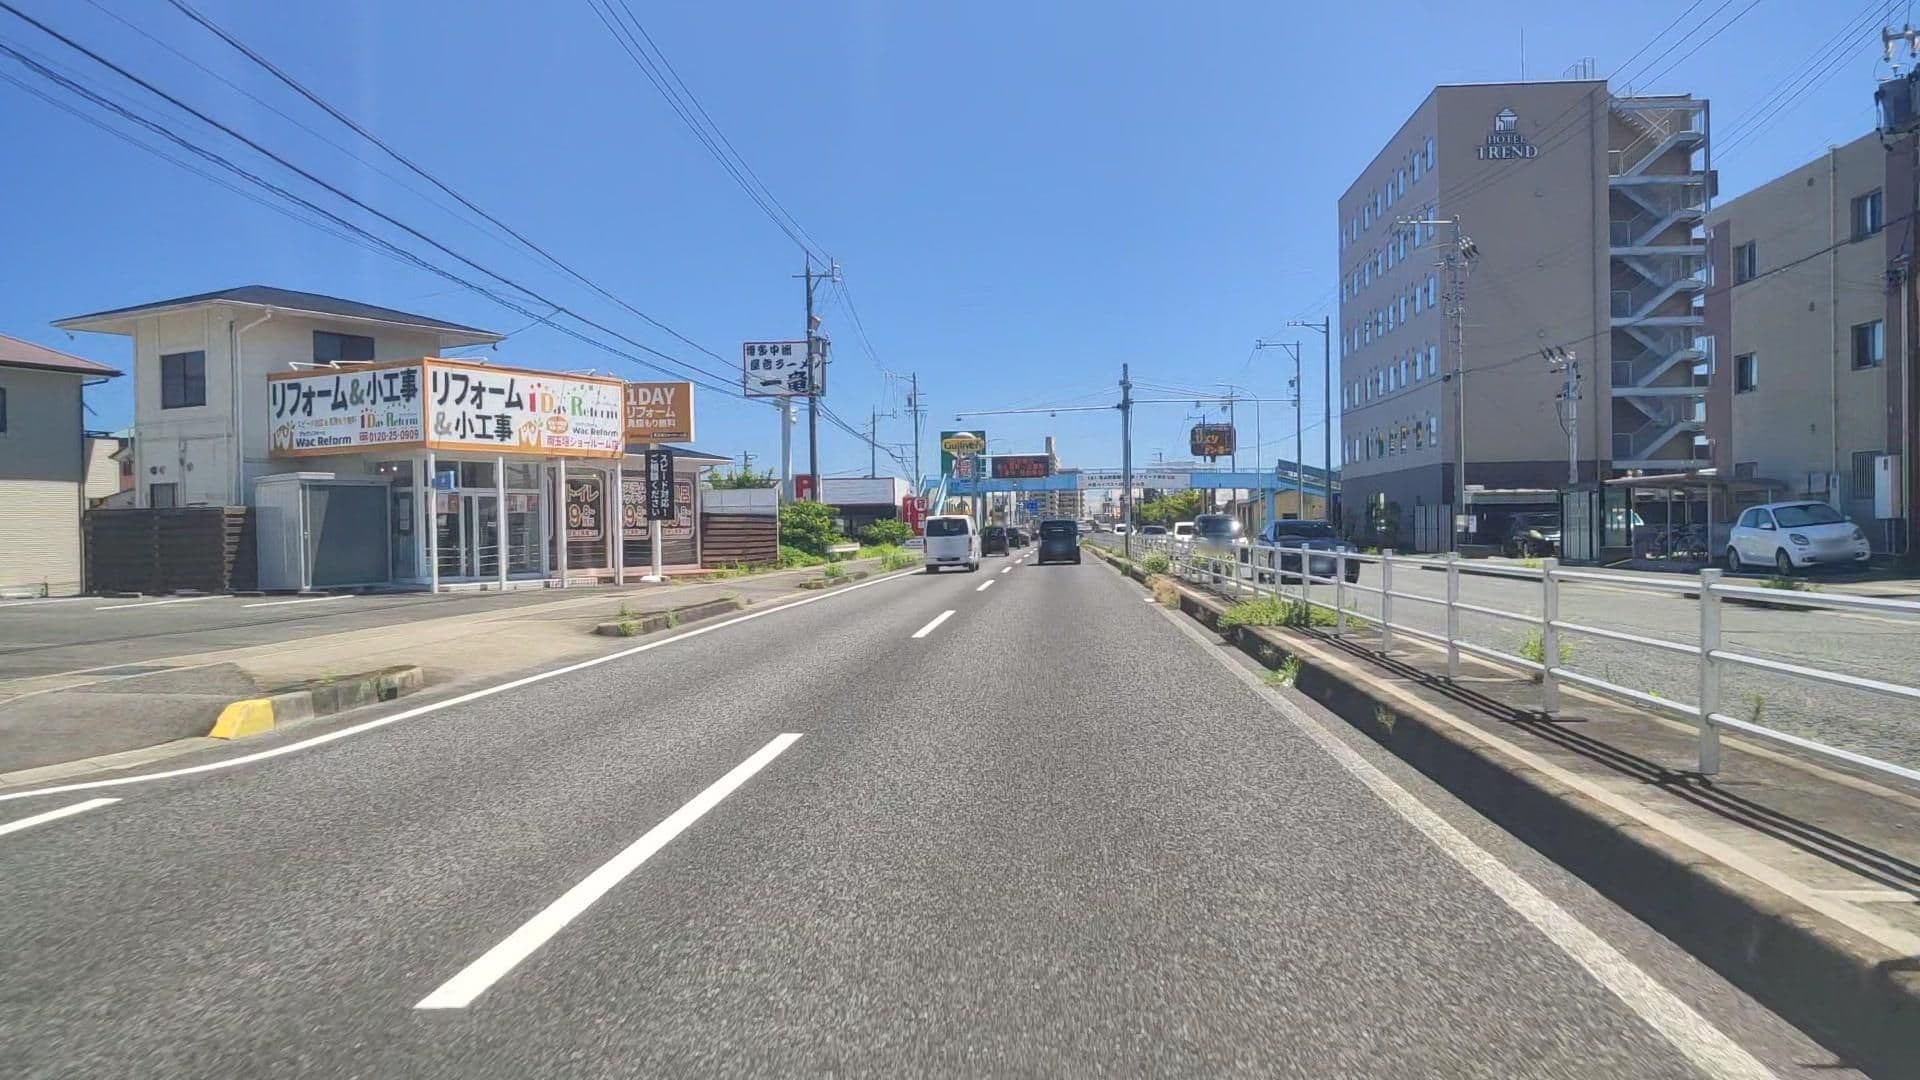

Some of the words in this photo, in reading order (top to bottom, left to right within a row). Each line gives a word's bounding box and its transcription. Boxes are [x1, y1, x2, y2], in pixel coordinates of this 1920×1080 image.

[1488, 135, 1526, 144] HOTEL
[1478, 145, 1538, 159] TREND
[432, 371, 524, 410] リフォーム
[627, 406, 676, 418] リフォーム
[369, 429, 419, 442] 0120-25-0909
[572, 426, 589, 435] Wac
[296, 437, 316, 448] Wac
[318, 435, 352, 446] Reform
[567, 483, 599, 502] トイレ
